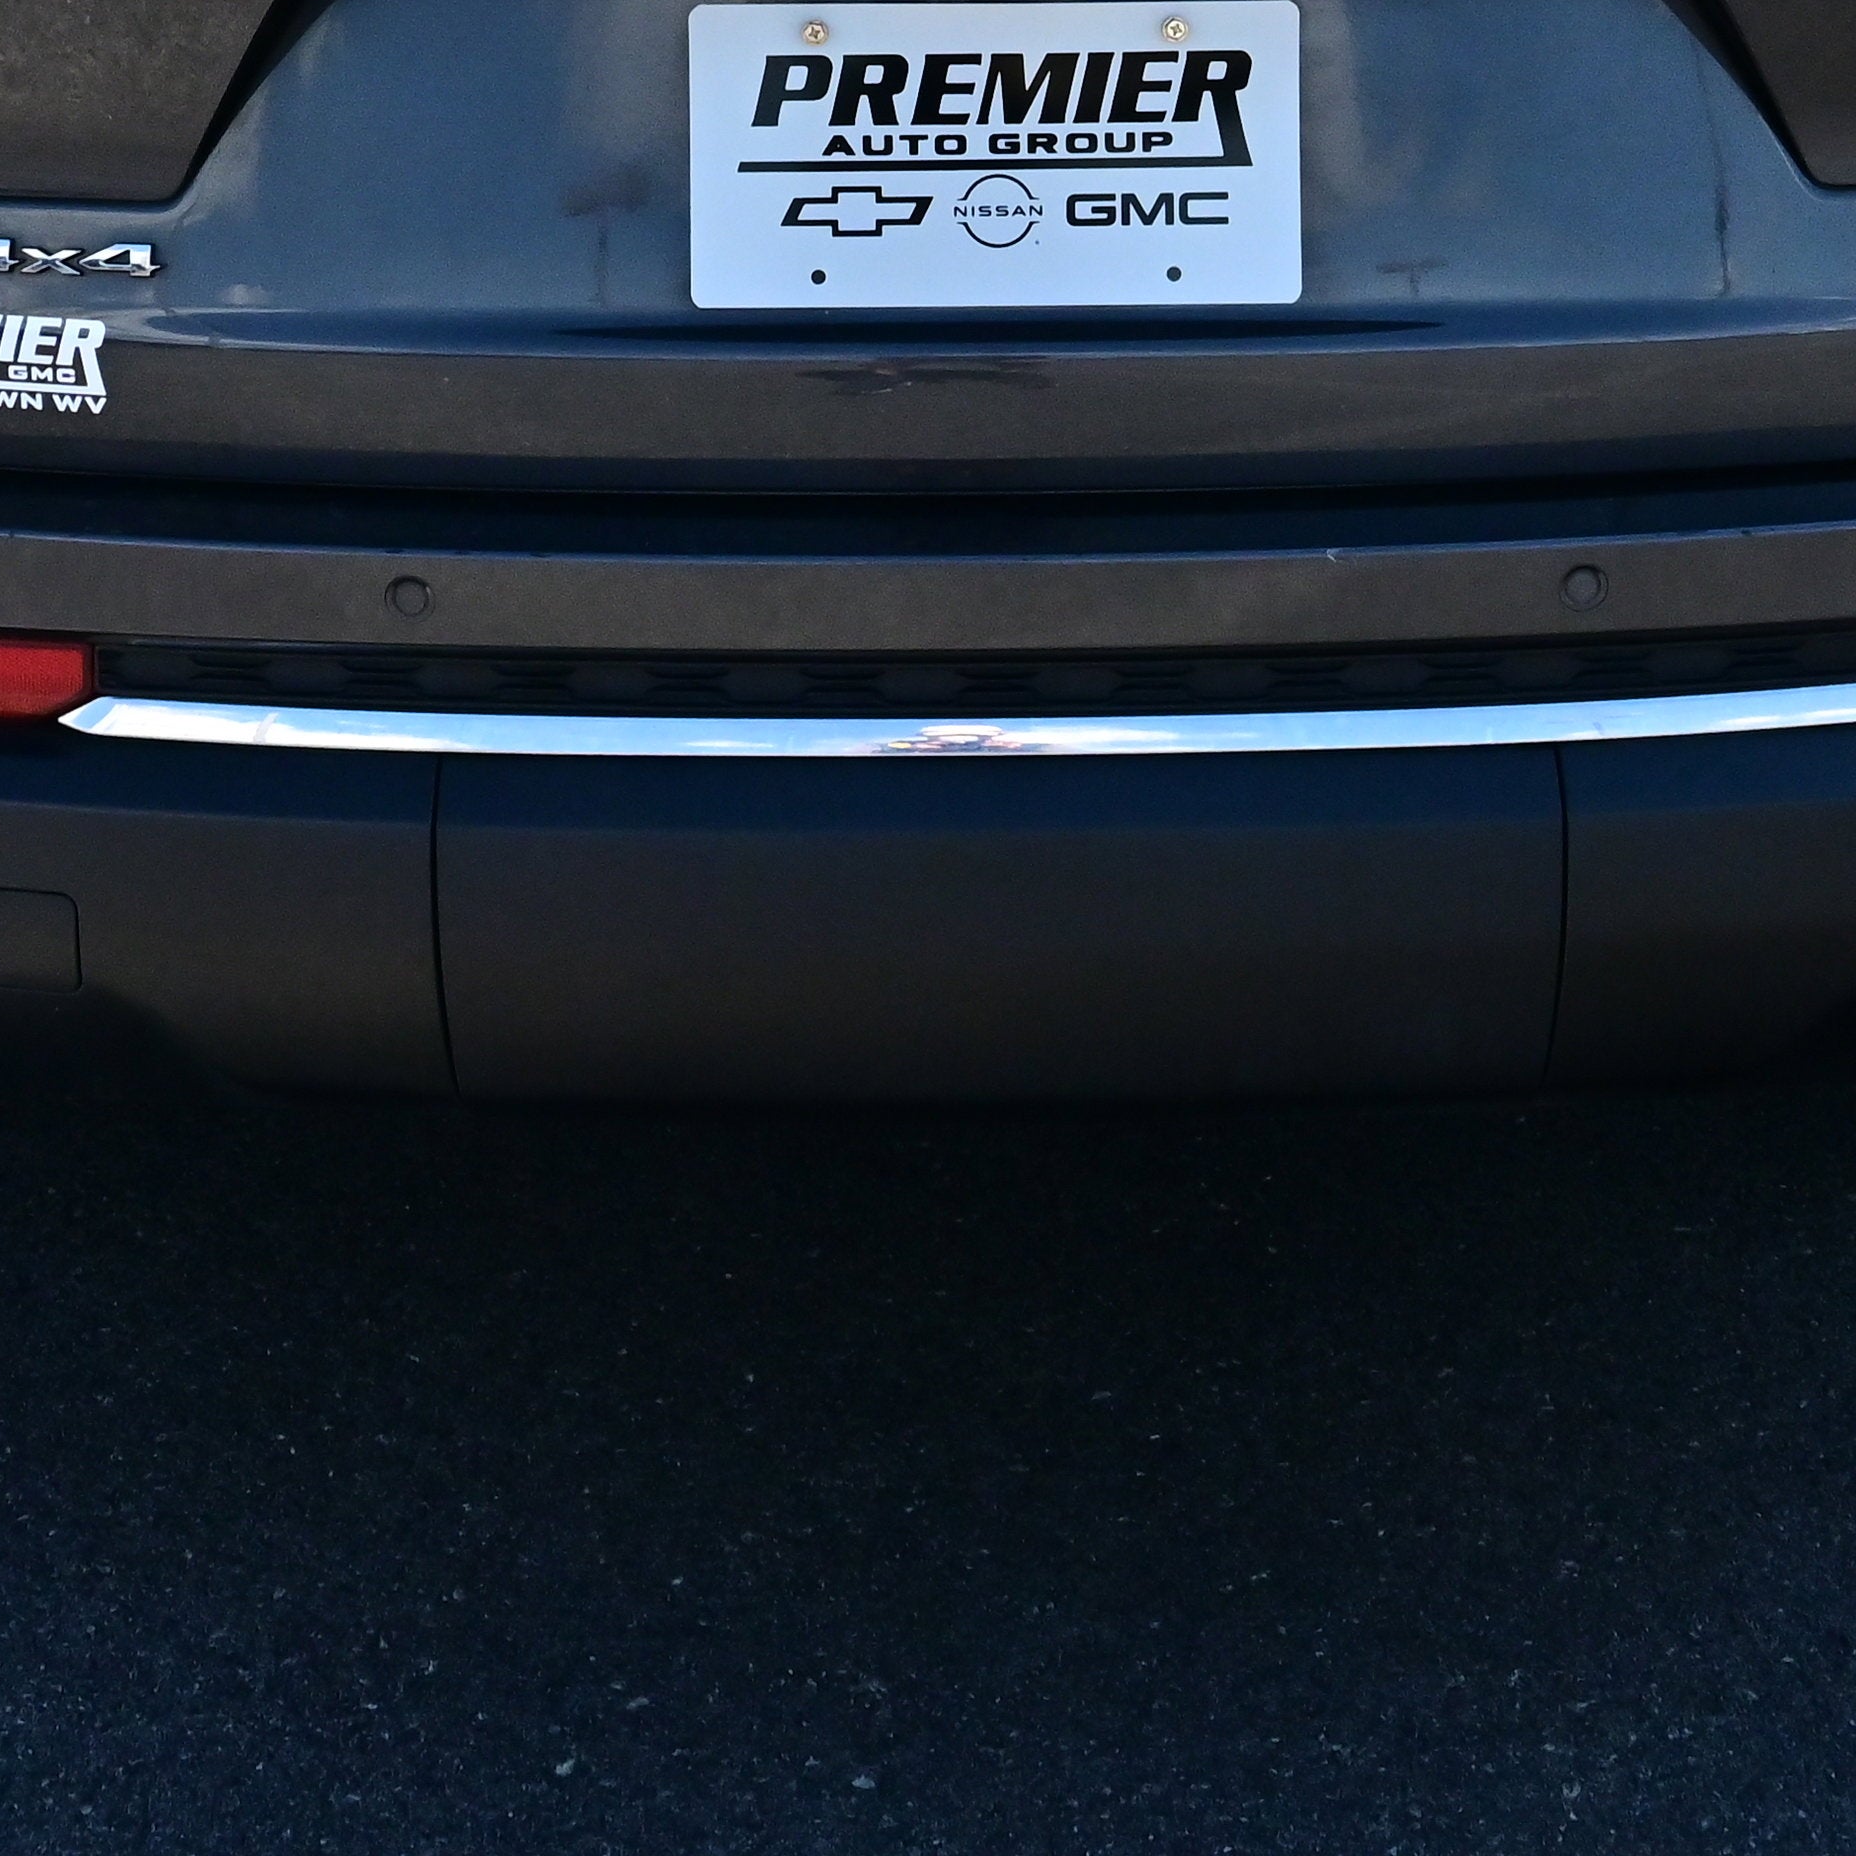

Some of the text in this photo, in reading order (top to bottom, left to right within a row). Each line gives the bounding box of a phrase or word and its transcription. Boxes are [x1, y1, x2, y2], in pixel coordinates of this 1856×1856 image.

[750, 50, 1253, 158] PREMIER
[821, 131, 1175, 156] AUTO GROUP
[953, 191, 1230, 227] NISSAN GMC
[7, 362, 78, 384] GMC
[52, 394, 108, 416] WV
